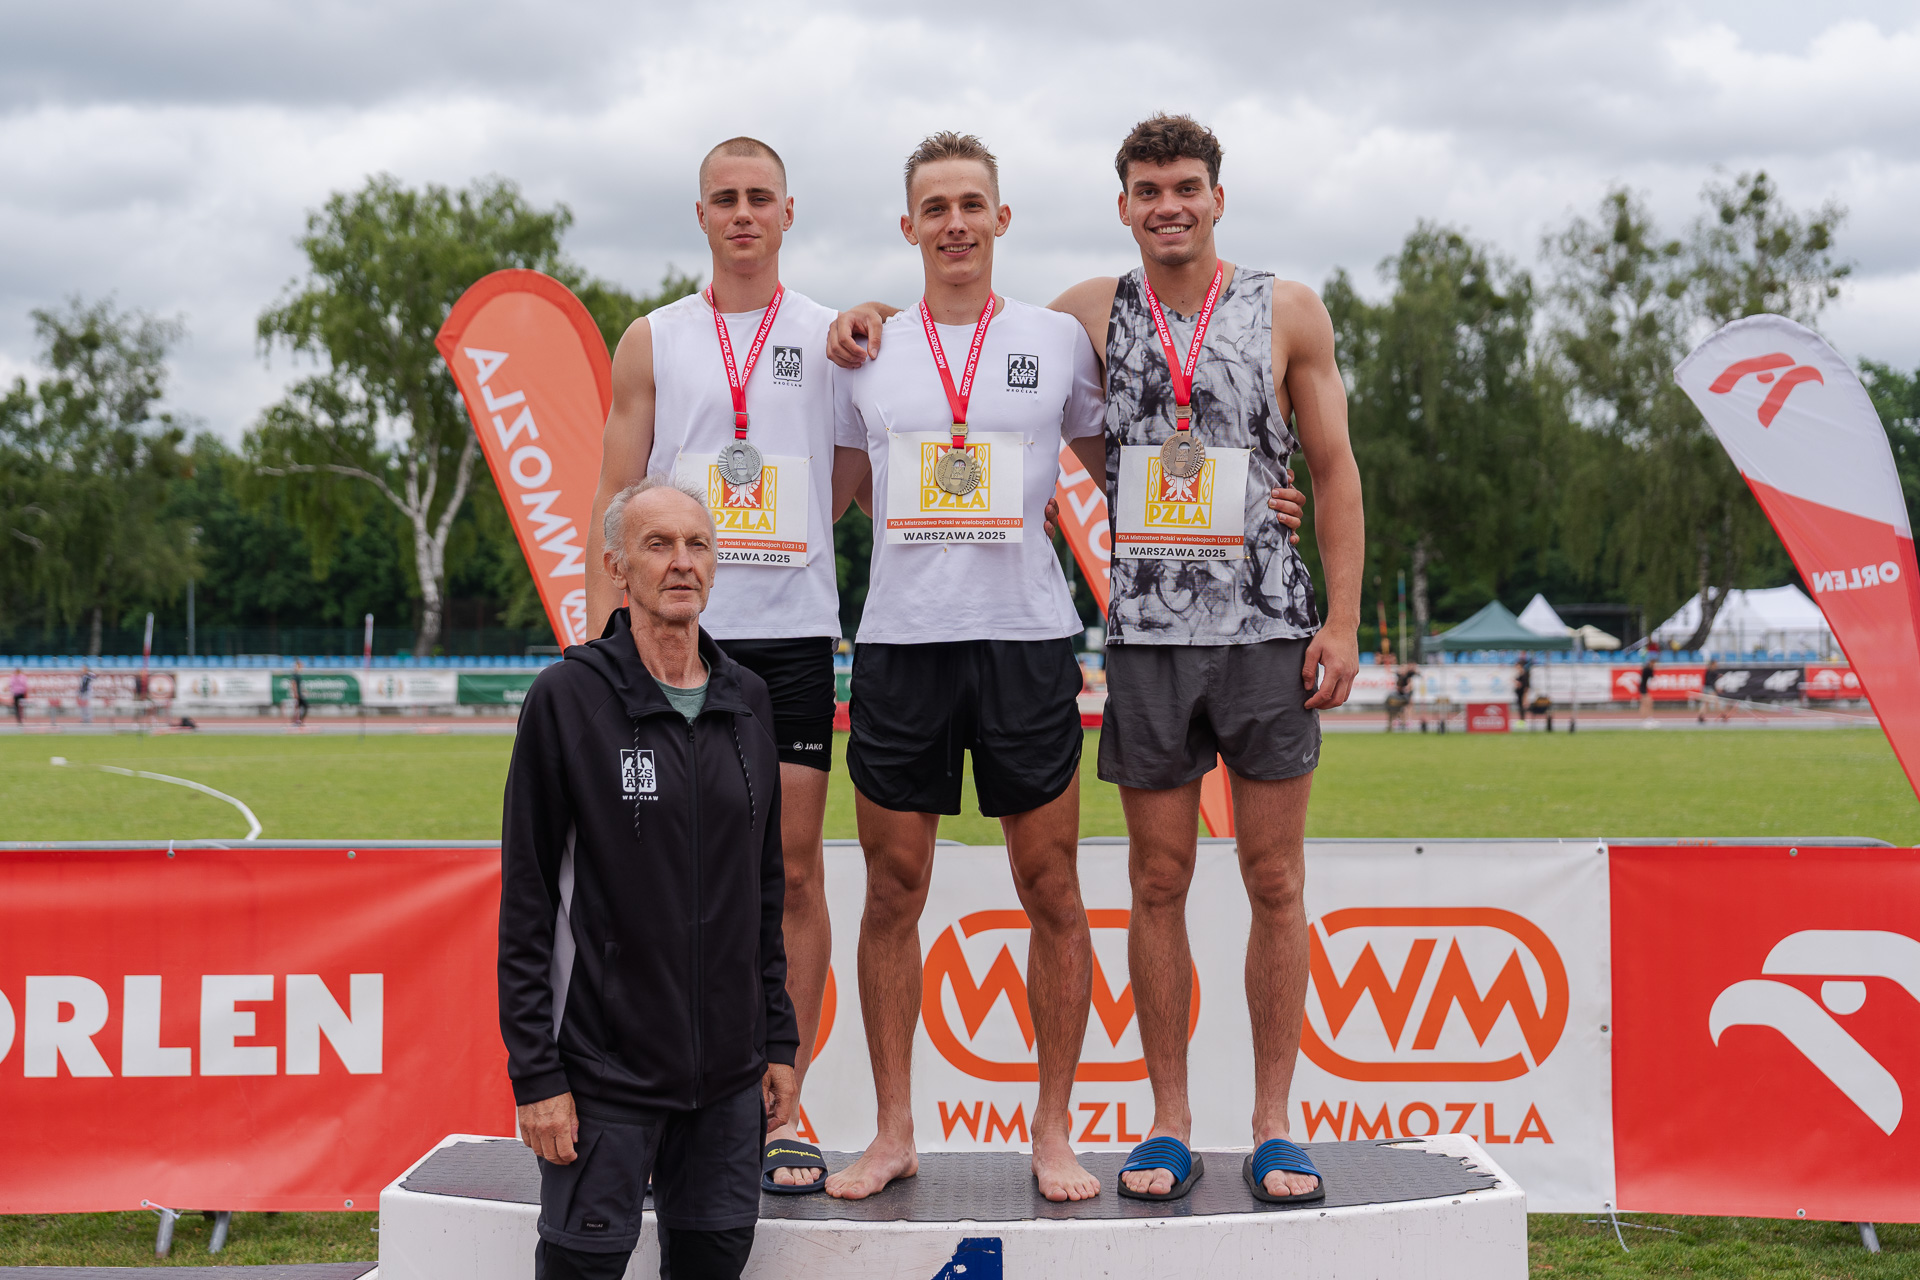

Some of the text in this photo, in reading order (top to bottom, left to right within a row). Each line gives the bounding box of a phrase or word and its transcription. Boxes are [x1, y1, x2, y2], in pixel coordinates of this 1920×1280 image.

[756, 291, 781, 341] MISTRZOSTWA
[1148, 293, 1172, 347] MISTRZOSTWA
[1185, 270, 1222, 376] MISTRZOSTWA POLSKI 2025
[747, 340, 761, 367] POLSKI
[925, 319, 946, 369] MISTRZOSTWA
[961, 298, 995, 396] MISTRZOSTWA POLSKI 2025
[721, 339, 738, 388] POLSKI 2025
[775, 361, 800, 370] AZS
[775, 369, 800, 378] AWF
[1009, 368, 1036, 377] AZS
[1009, 376, 1036, 385] AWF
[924, 489, 986, 508] PZLA
[1148, 504, 1207, 525] PZLA
[748, 541, 780, 549] wielobojach
[904, 531, 1006, 540] WARSZAWA 2025
[717, 551, 791, 563] SZAWA 2025
[1129, 547, 1226, 558] WARSZAWA 2025
[0, 972, 384, 1078] RLEN
[938, 1100, 1156, 1144] WMZL
[1301, 1100, 1555, 1145] WMOZLA
[767, 1148, 820, 1159] Champion
